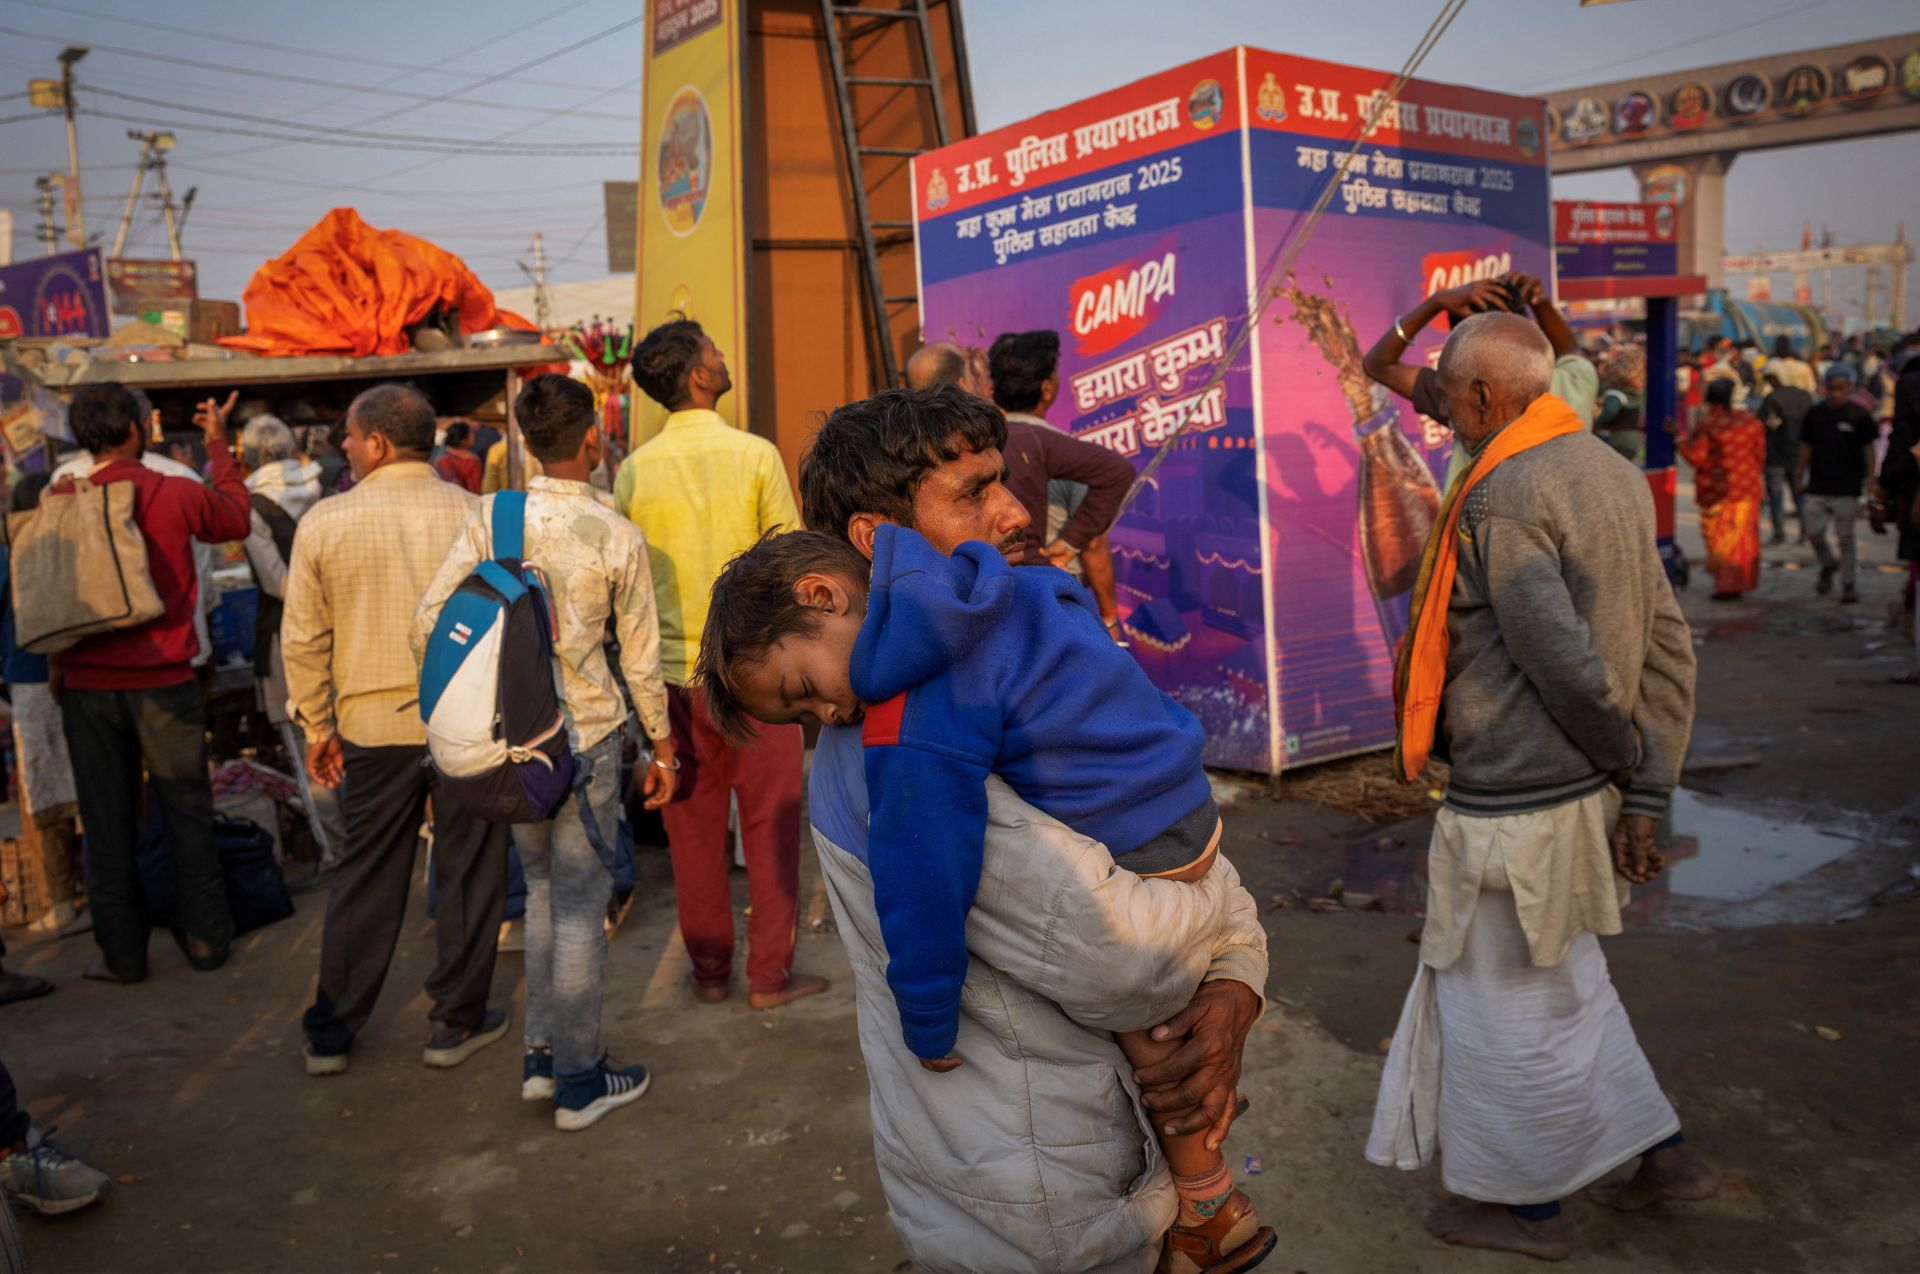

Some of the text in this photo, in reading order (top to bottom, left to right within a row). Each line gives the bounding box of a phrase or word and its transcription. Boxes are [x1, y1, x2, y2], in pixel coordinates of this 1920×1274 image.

[1005, 133, 1068, 187] पुलिस
[1073, 97, 1181, 158] प्रयागराज
[1355, 89, 1419, 137] पुलिस
[1020, 195, 1053, 222] मेला
[1055, 173, 1133, 212] प्रयागराज
[1137, 157, 1184, 191] 2025
[1341, 178, 1388, 214] पुलिस
[1479, 166, 1515, 192] 2025
[993, 228, 1035, 265] पुलिस
[1039, 213, 1101, 247] सहायता
[1075, 252, 1176, 335] CAMPA
[1073, 322, 1224, 410] हमारा कुम्भ
